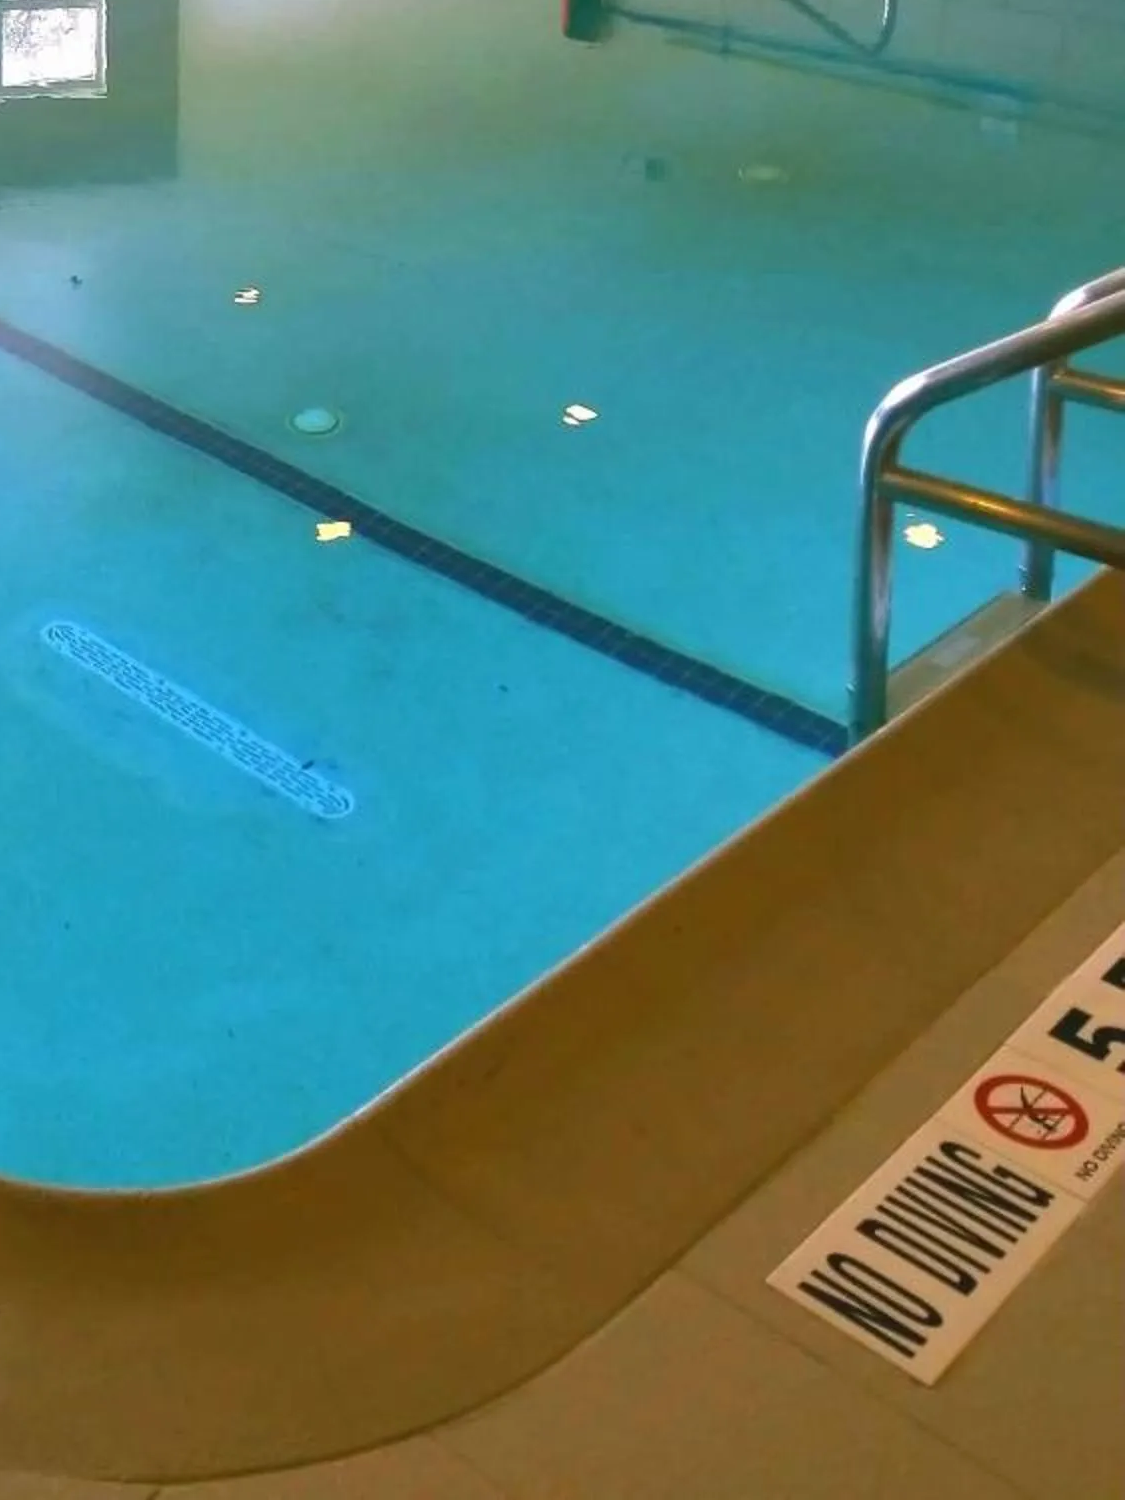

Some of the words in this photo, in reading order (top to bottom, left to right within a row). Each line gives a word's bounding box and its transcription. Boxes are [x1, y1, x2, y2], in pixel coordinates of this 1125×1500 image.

[854, 1140, 1056, 1297] DIVING
[1074, 1160, 1099, 1182] NO
[796, 1252, 944, 1358] NO
